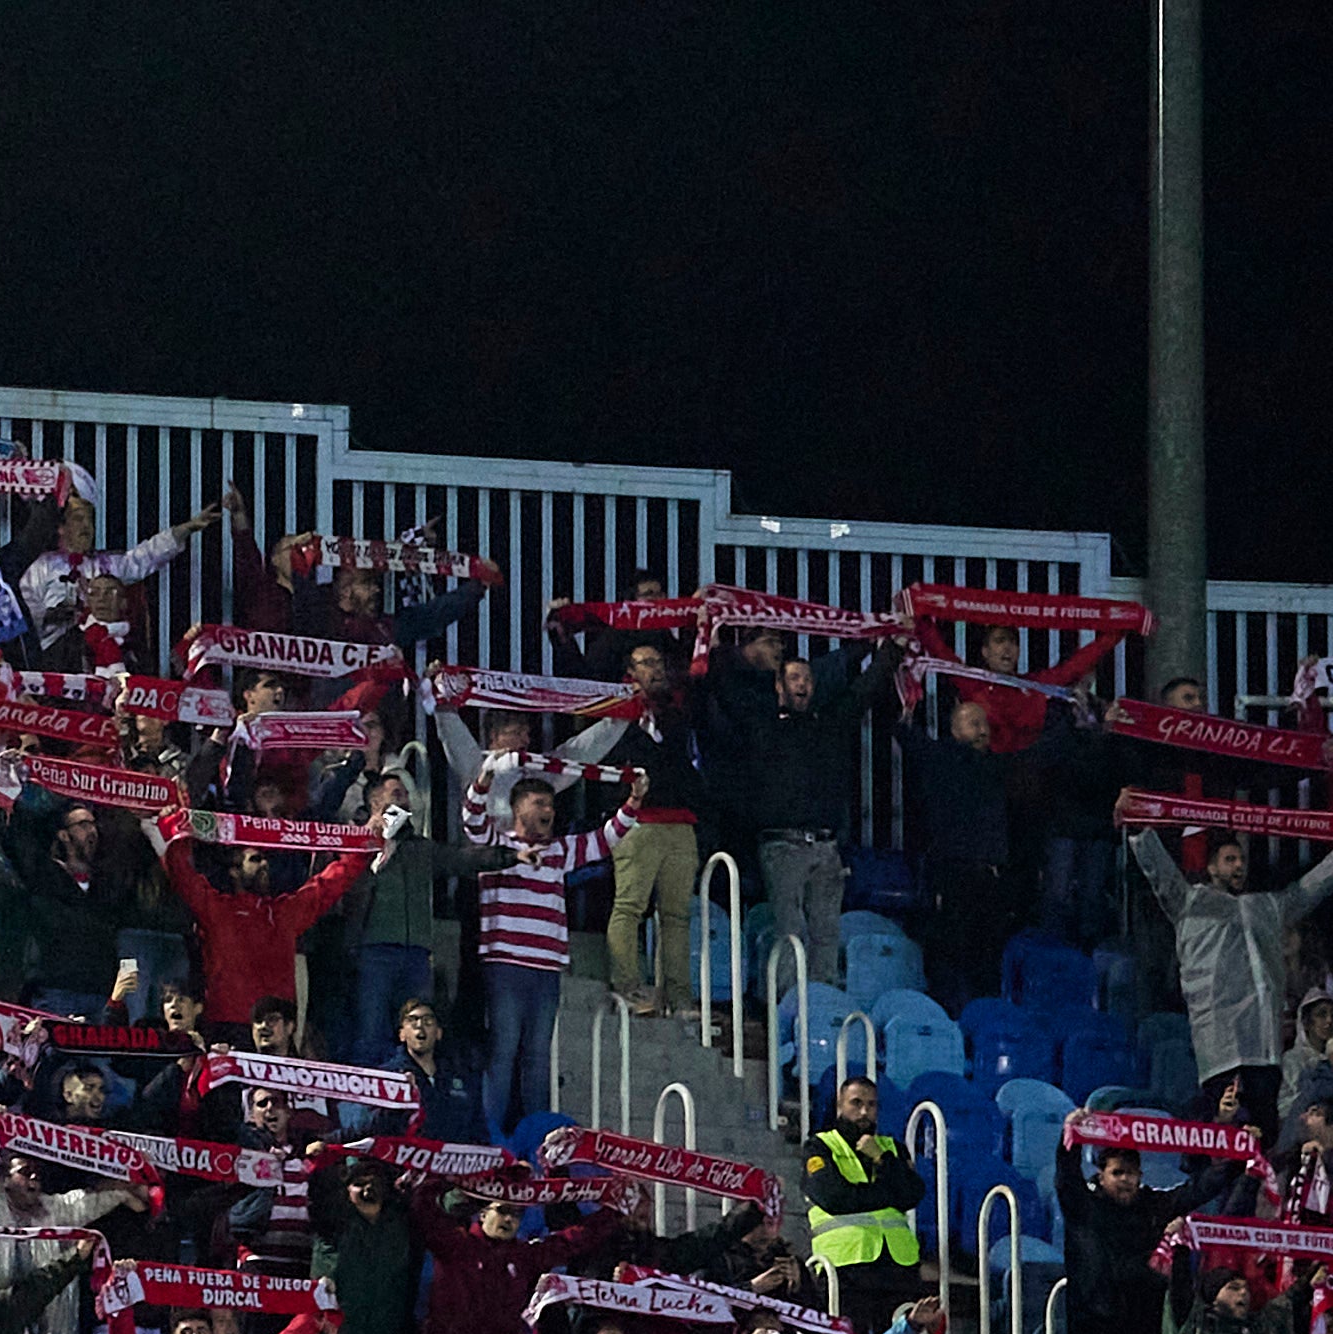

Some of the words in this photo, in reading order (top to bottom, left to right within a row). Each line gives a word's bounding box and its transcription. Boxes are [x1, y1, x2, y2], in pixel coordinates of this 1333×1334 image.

[1010, 605, 1041, 617] CLUB
[1043, 607, 1057, 619] DE
[220, 637, 336, 666] GRANADA
[1157, 716, 1262, 753] GRANADA
[30, 758, 63, 790] Peña
[69, 768, 97, 793] Sur
[1171, 805, 1229, 823] GRANADA
[1231, 811, 1264, 826] CLUB
[1267, 815, 1283, 826] DE
[53, 1025, 160, 1049] GRANADA
[1131, 1120, 1228, 1150] GRANADA
[1255, 1230, 1282, 1243] CLUB
[1286, 1232, 1301, 1245] DE
[188, 1270, 234, 1287] FUERA
[243, 1274, 262, 1289] DE
[266, 1277, 312, 1293] JUEGO
[202, 1288, 263, 1308] DURCAL
[577, 1279, 644, 1306] Eterna
[649, 1288, 717, 1317] Lucha
